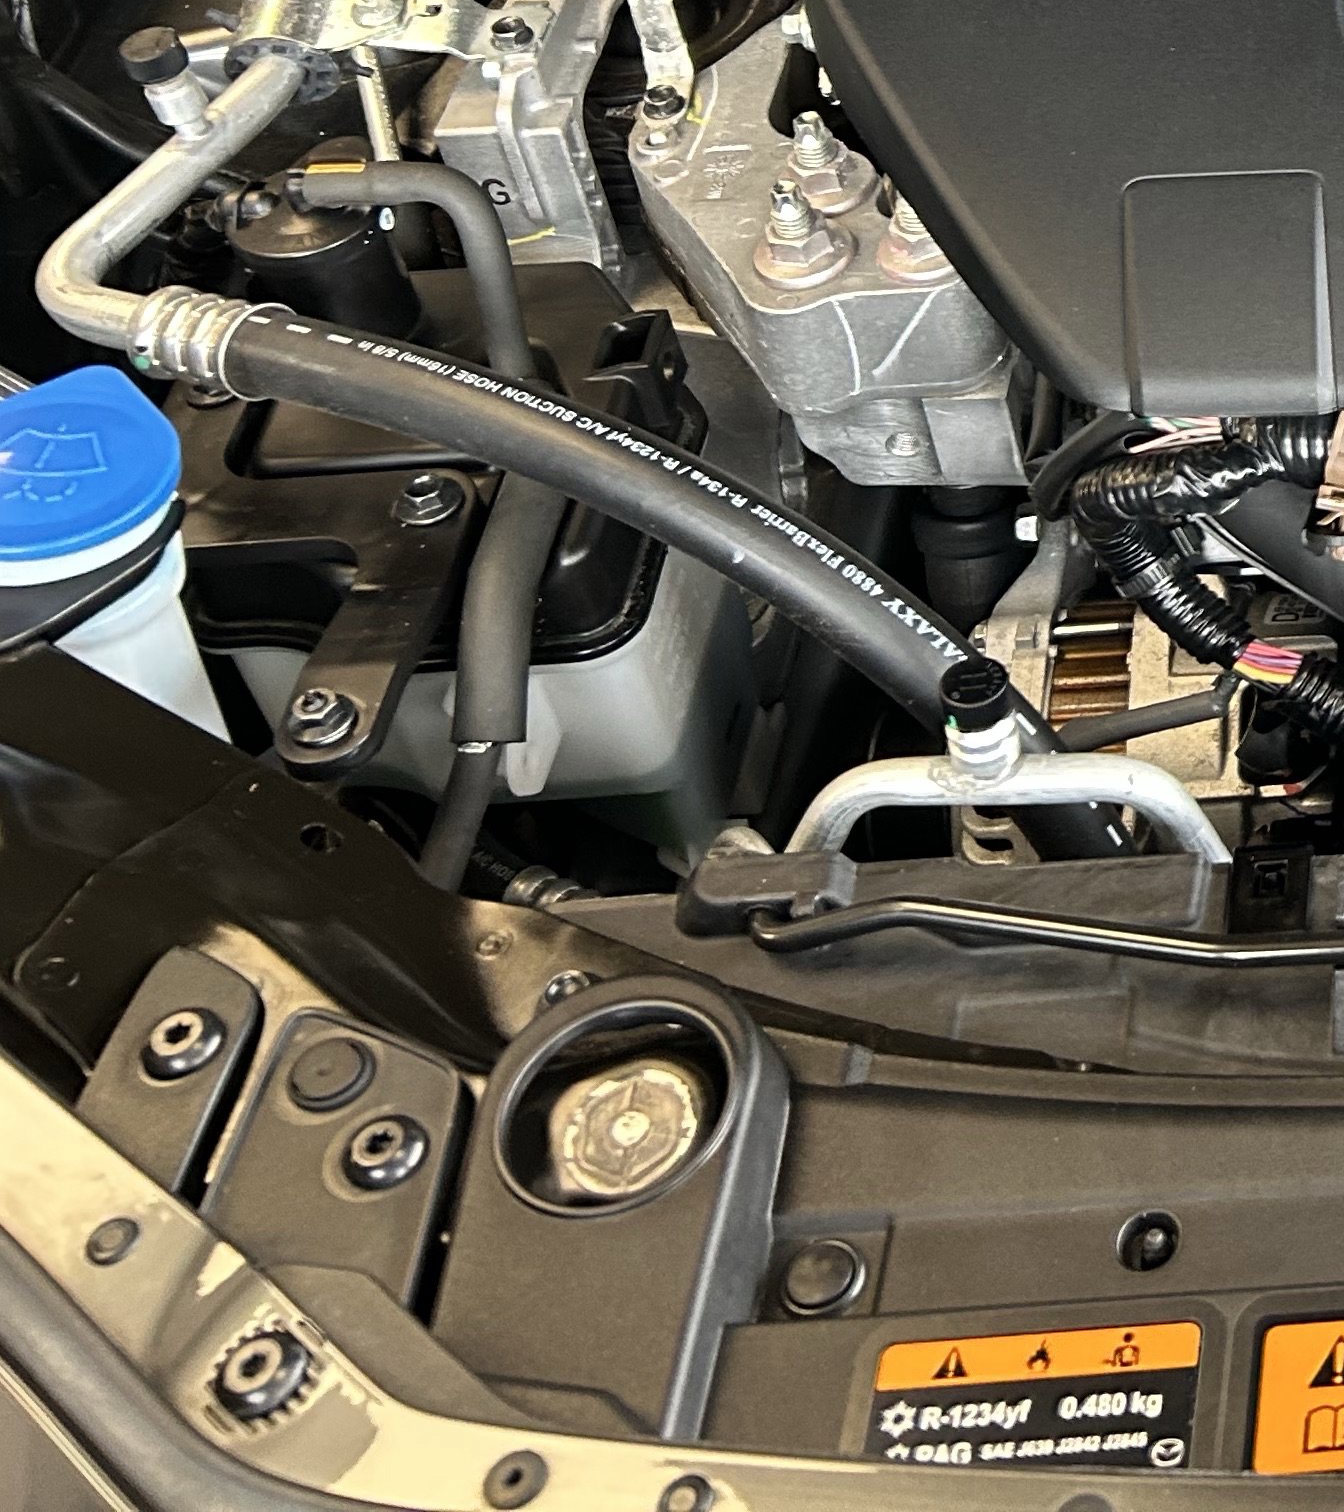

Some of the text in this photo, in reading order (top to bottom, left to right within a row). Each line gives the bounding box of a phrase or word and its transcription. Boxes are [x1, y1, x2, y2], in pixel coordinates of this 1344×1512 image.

[372, 345, 399, 359] 5/8
[397, 351, 457, 376] (16mm)
[452, 369, 503, 393] HOSE
[501, 387, 578, 423] SUCTION
[575, 416, 611, 436] A/C
[606, 430, 681, 471] R-1234yf
[690, 469, 749, 509] R-134a
[750, 504, 846, 570] FlexBarrier
[841, 564, 885, 597] 4880
[881, 597, 969, 662] ALAXY
[918, 1390, 1164, 1431] R-1234yf 0.480 kg
[978, 1441, 1016, 1461] SAE
